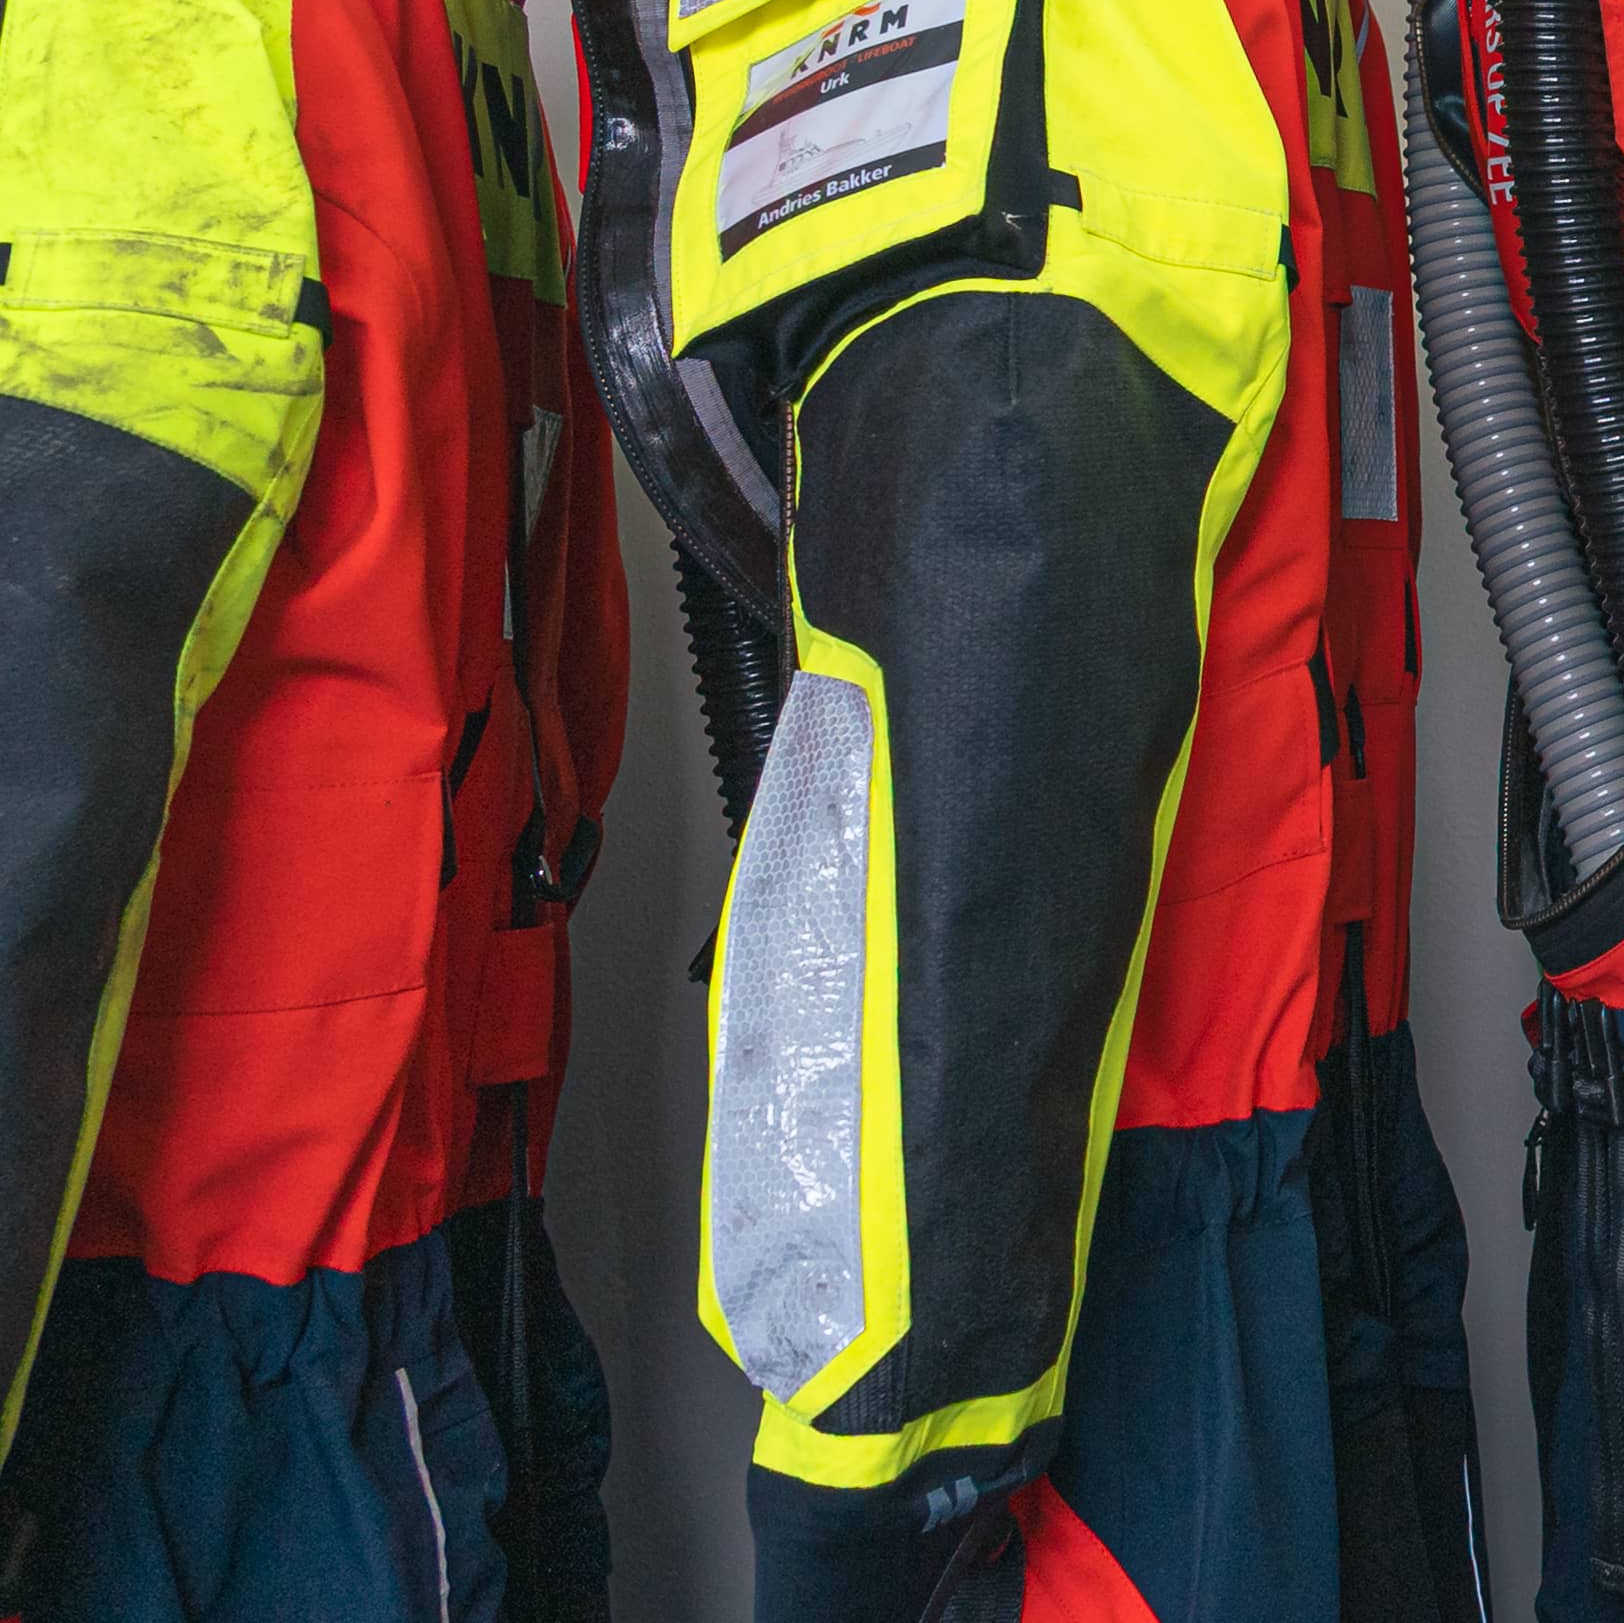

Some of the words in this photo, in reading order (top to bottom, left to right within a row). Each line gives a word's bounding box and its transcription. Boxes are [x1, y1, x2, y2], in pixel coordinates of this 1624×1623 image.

[792, 4, 909, 78] KNRM
[857, 36, 918, 63] LIFEBOAT
[820, 72, 850, 95] Urk
[757, 190, 821, 229] Andries
[826, 164, 892, 197] Bakker
